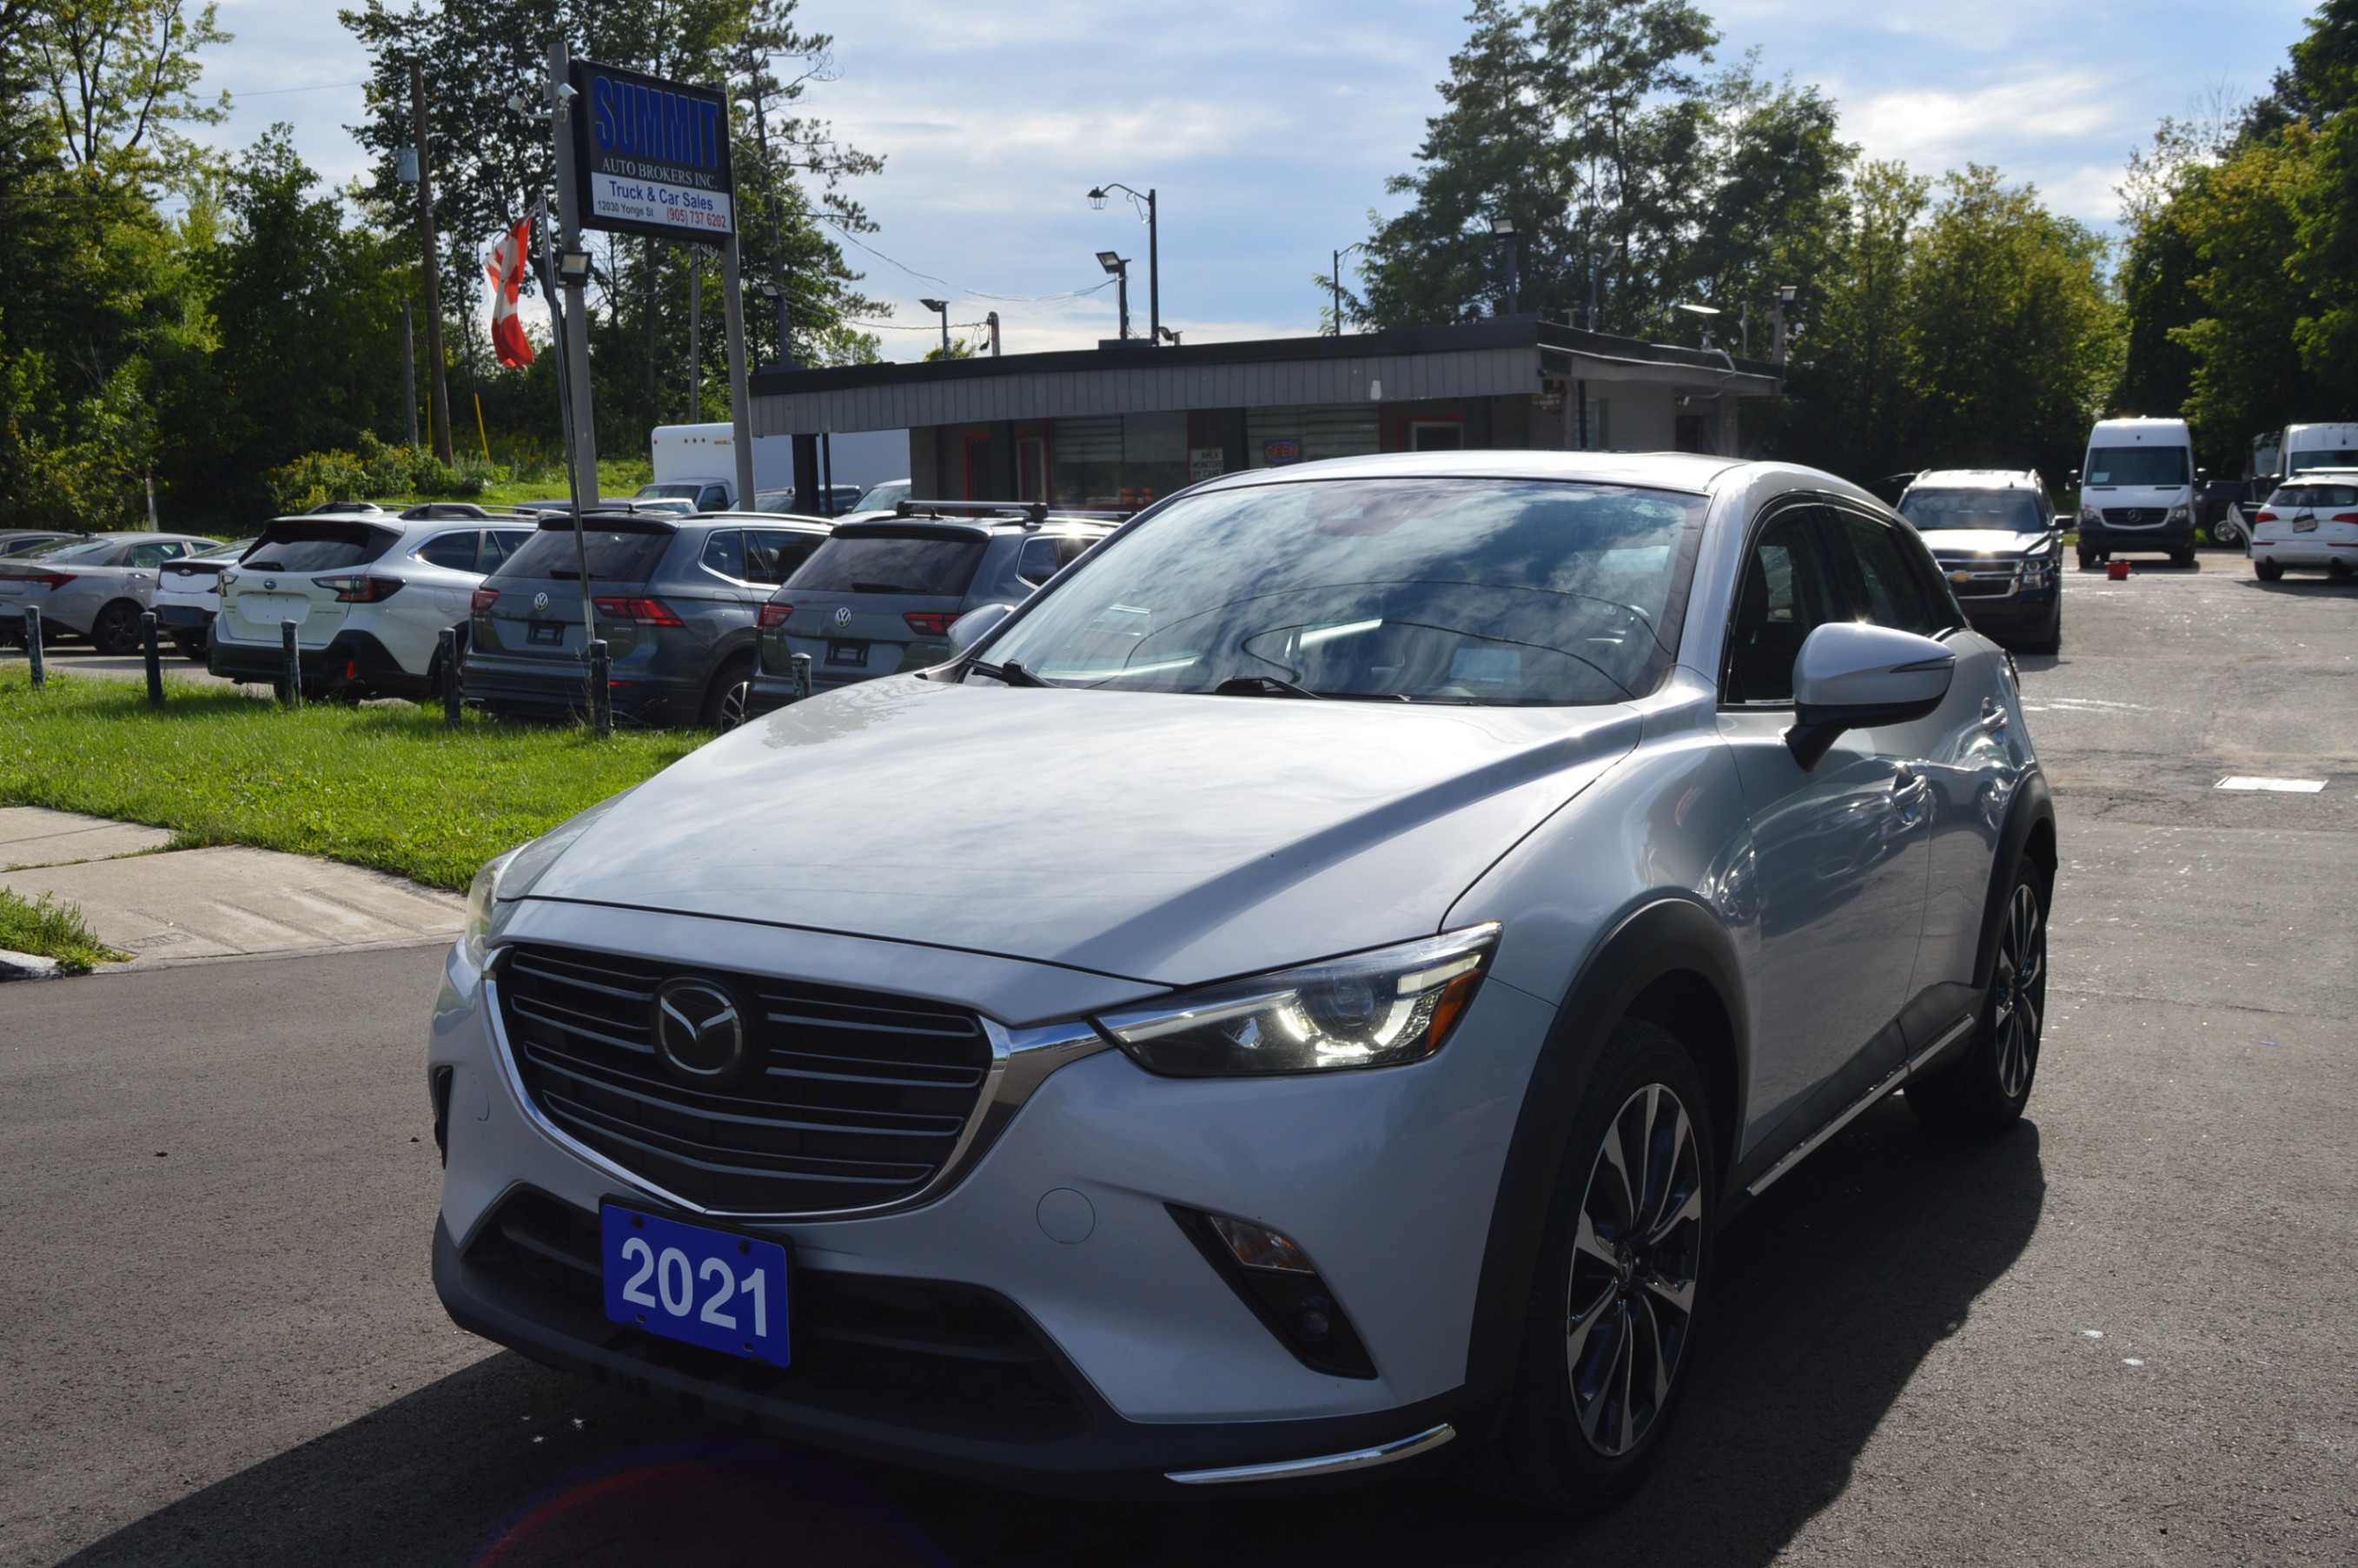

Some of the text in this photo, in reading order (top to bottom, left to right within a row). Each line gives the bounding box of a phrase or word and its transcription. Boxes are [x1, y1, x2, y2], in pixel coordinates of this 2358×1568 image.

[594, 76, 719, 169] SUMMIT
[602, 157, 719, 189] AUTO BROKERS INC.
[598, 200, 654, 217] 12030 Yonge St
[609, 180, 714, 211] Truck & Car Sales
[666, 207, 727, 228] (905) 737 6202
[1266, 445, 1299, 457] OPEN
[1193, 460, 1223, 469] MONITORE
[621, 1236, 767, 1338] 2021
